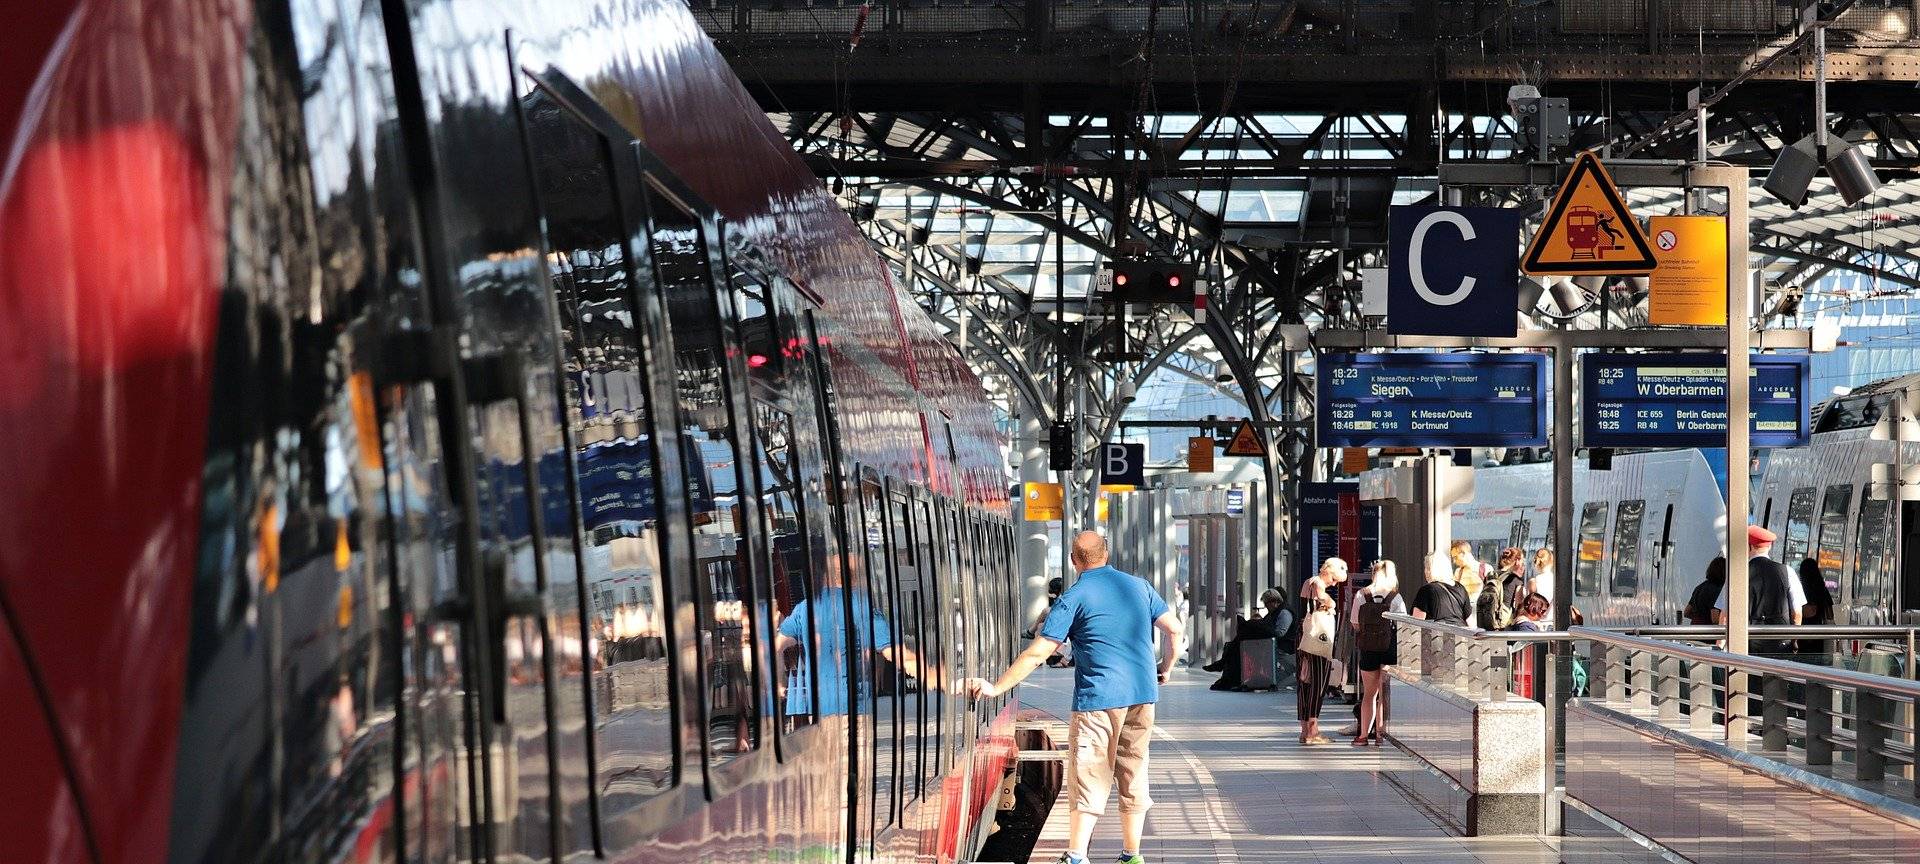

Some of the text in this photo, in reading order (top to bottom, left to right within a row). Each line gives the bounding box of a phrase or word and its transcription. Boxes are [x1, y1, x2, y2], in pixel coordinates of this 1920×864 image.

[1408, 210, 1477, 306] C
[1332, 368, 1358, 379] 18:23
[1599, 368, 1624, 378] 18:25
[1451, 375, 1478, 383] Troisdorf
[1371, 384, 1408, 398] Siegen
[1637, 383, 1724, 396] W Oberbarmen
[1332, 410, 1354, 419] 18:28
[1371, 410, 1382, 418] RB
[1411, 410, 1418, 418] K
[1420, 410, 1473, 419] Messe/Deutz
[1598, 410, 1620, 418] 18:48
[1637, 410, 1648, 418] ICE
[1649, 410, 1664, 418] 655
[1676, 410, 1699, 419] Berlin
[1332, 421, 1354, 430] 18:46
[1381, 421, 1398, 429] 1918
[1411, 421, 1449, 430] Dortmund
[1598, 421, 1727, 430] 19:25 RB 48 W Oberbarm
[1106, 444, 1129, 476] B
[1303, 496, 1326, 504] Abfahrt
